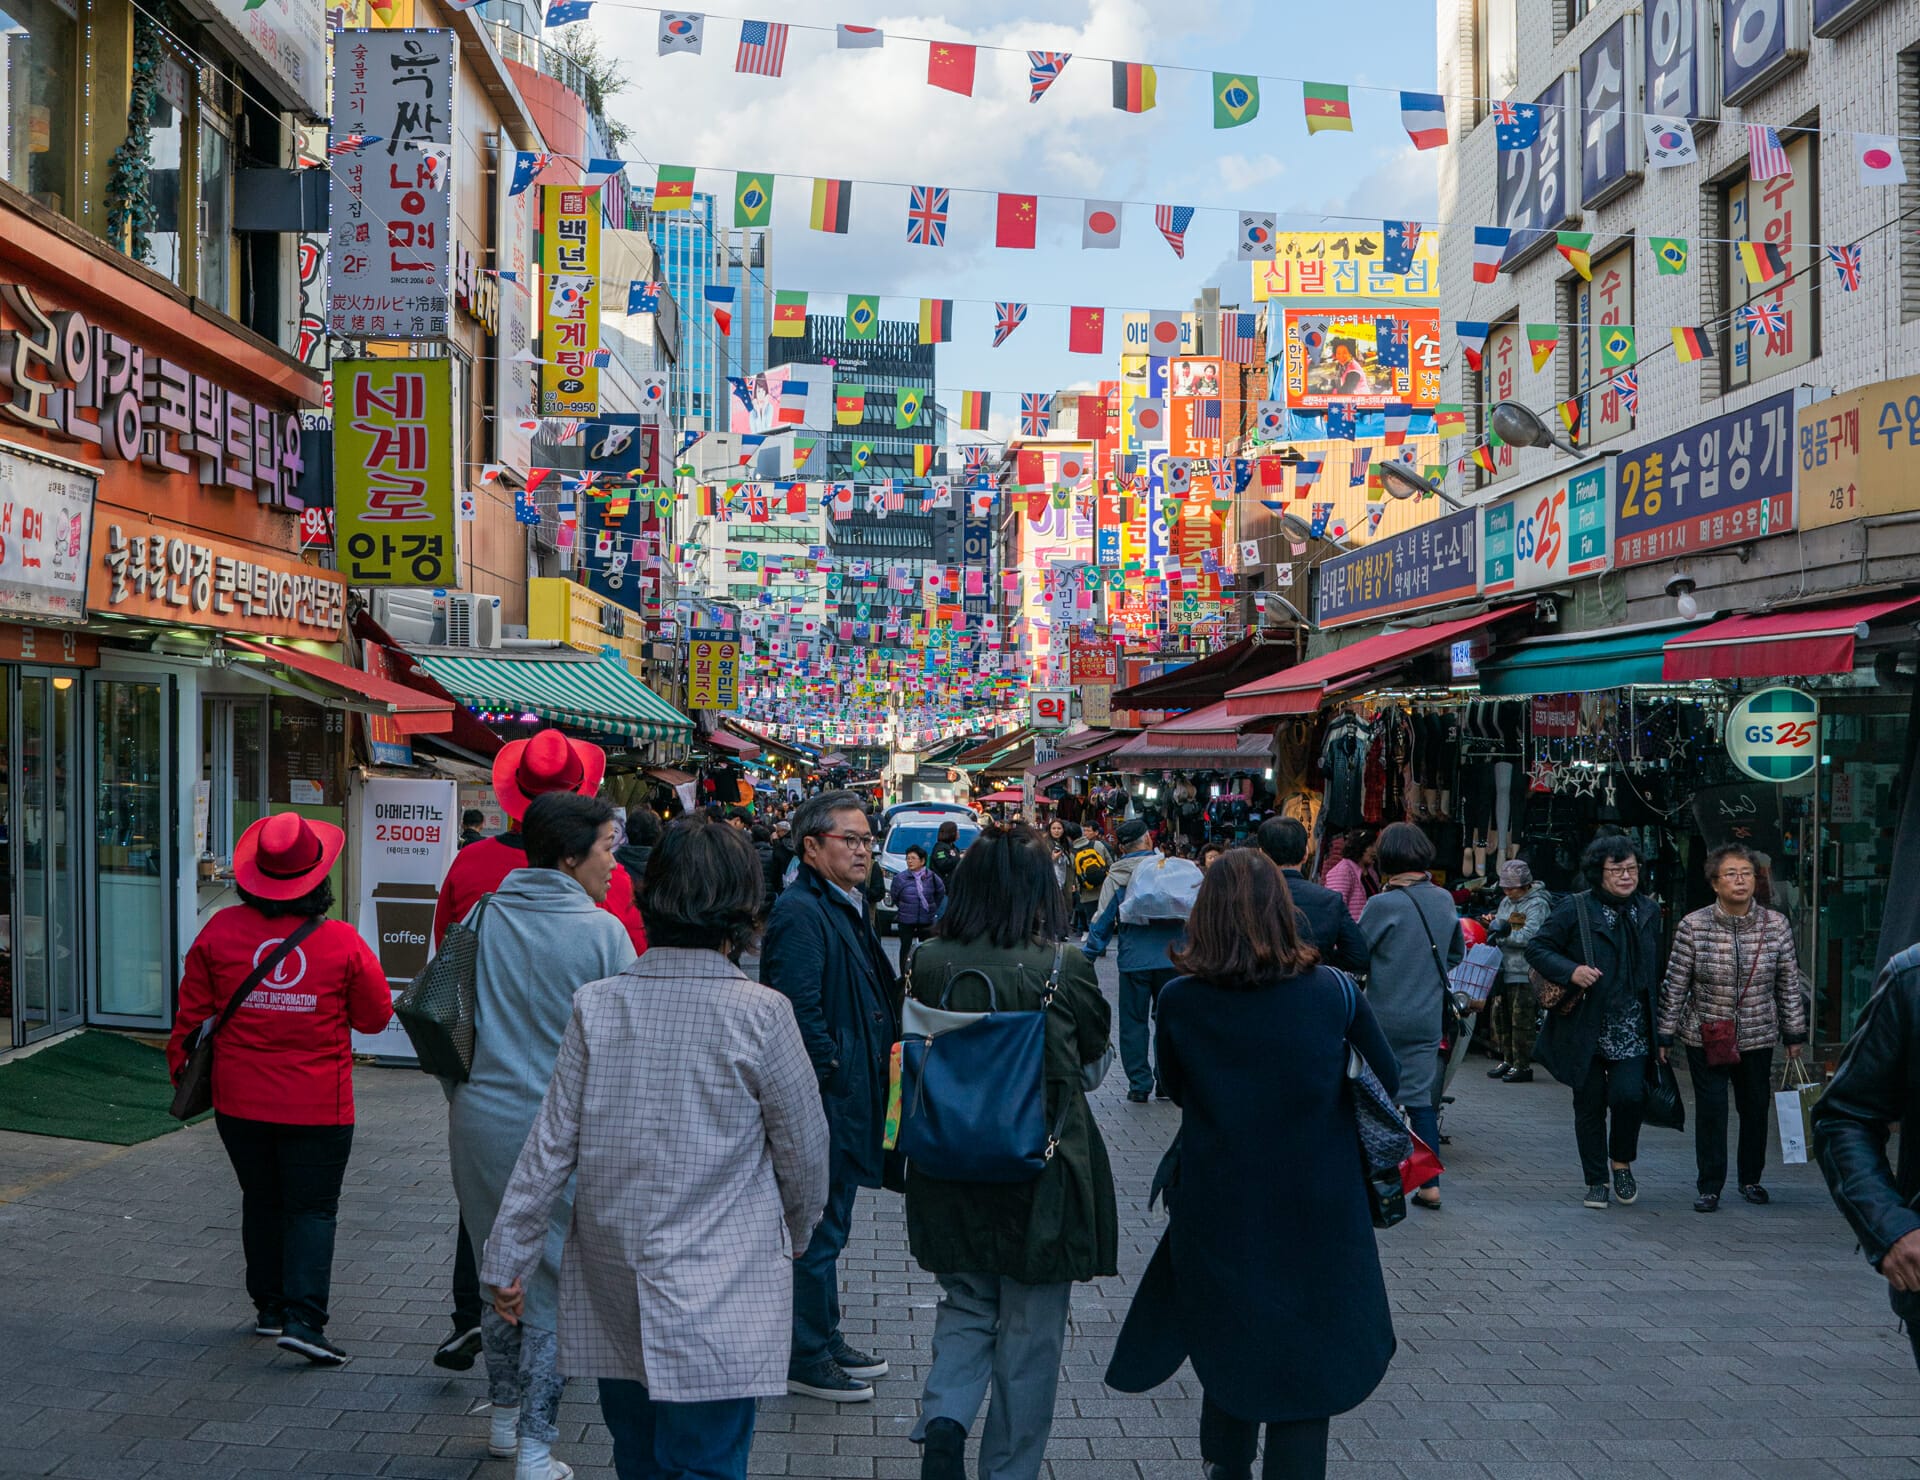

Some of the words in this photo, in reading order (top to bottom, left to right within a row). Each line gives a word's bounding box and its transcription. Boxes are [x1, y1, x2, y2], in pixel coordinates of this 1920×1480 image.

[350, 43, 368, 115] 숯불고기
[343, 254, 367, 273] 2F
[390, 277, 408, 285] SINCE
[544, 391, 558, 400] 02)
[564, 381, 580, 393] 2F
[544, 401, 596, 413] 310-9950
[350, 371, 437, 522] 세계로
[1800, 407, 1860, 472] 명품구제
[1621, 452, 1663, 520] 2층
[1670, 406, 1787, 507] 수입상가
[1575, 477, 1599, 504] Friendly
[1829, 487, 1845, 510] 2층
[1516, 487, 1566, 571] GS25
[1581, 534, 1593, 558] Fun
[1621, 526, 1686, 561] 개점:밤11시
[348, 532, 443, 582] 안경
[1494, 560, 1505, 580] Fun
[1037, 698, 1066, 722] 약
[1745, 720, 1818, 748] GS25
[375, 803, 444, 822] 아메리카노
[386, 846, 410, 856] (테이크
[412, 847, 430, 857] 아웃)
[383, 929, 427, 945] coffee
[269, 991, 318, 1007] INFORMATION
